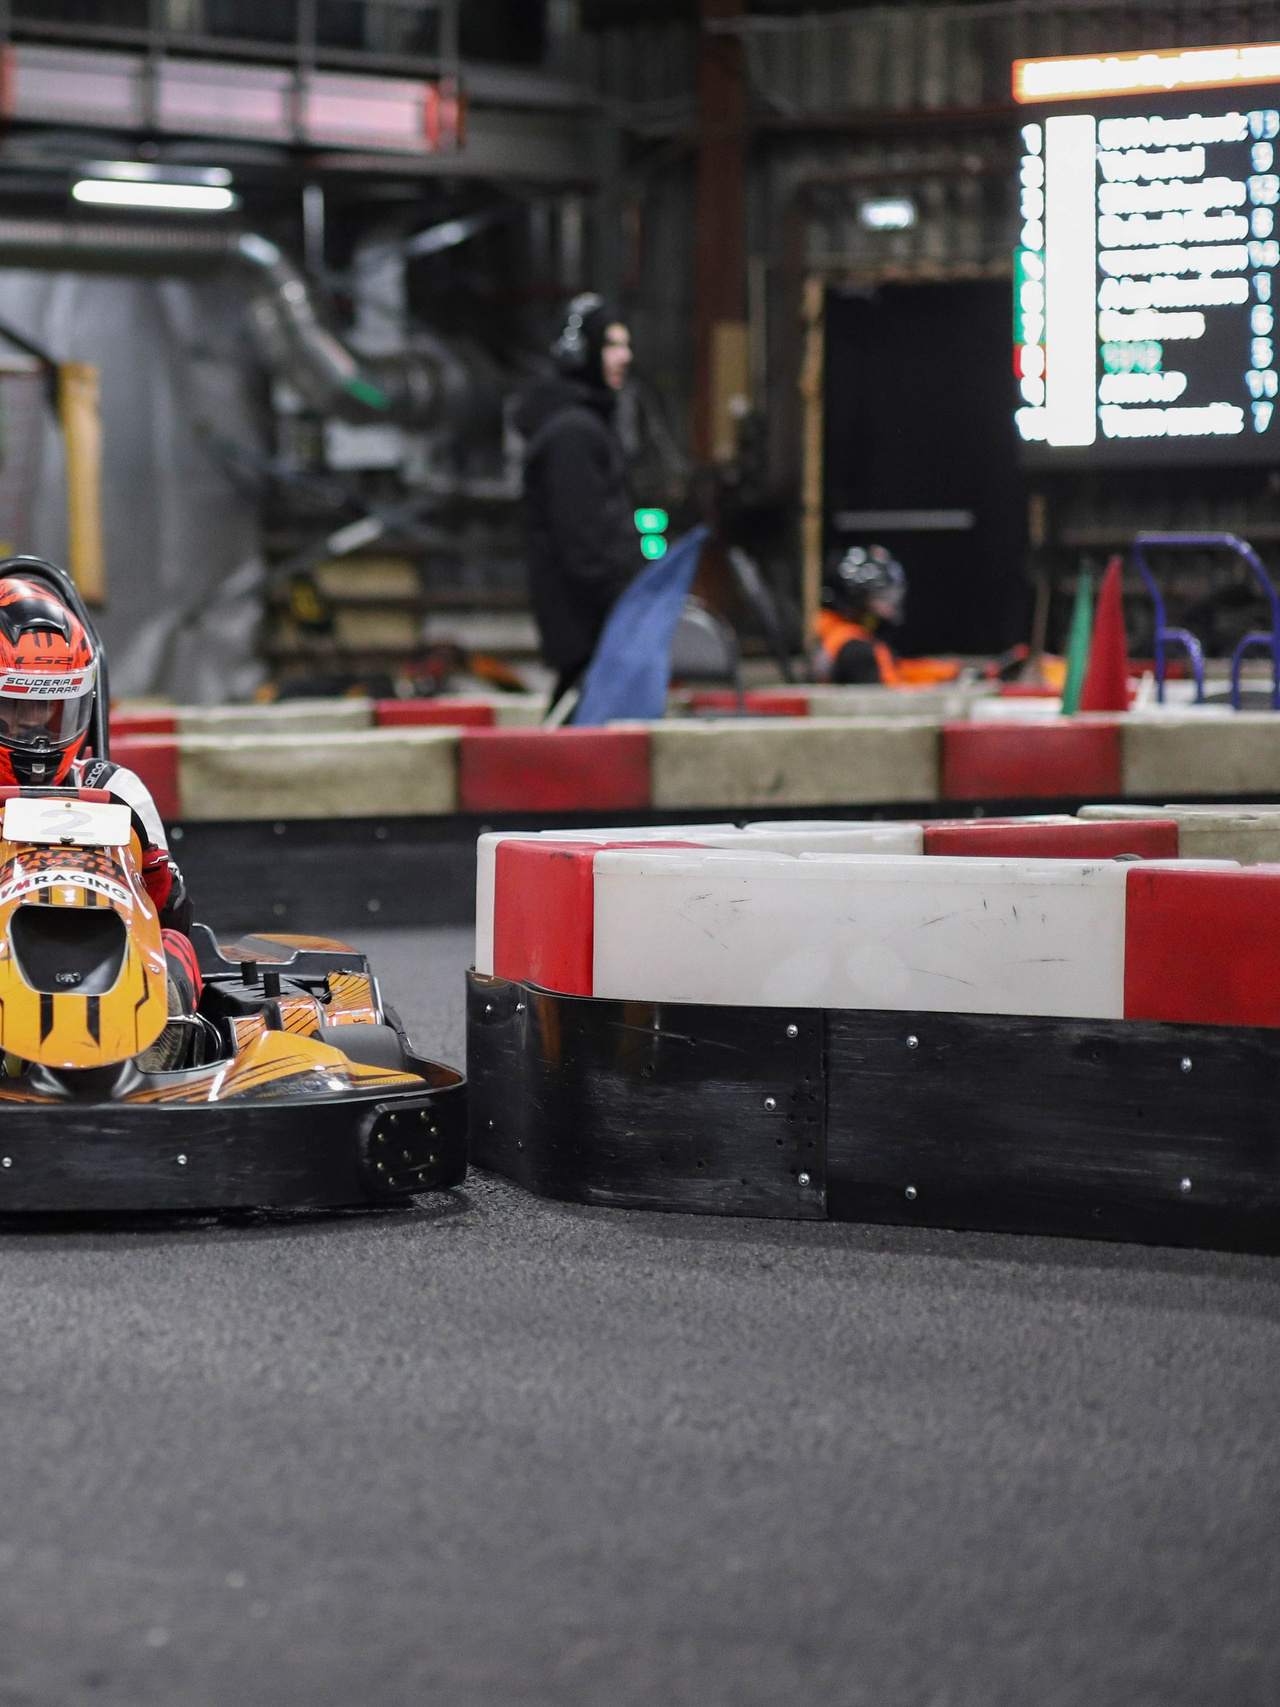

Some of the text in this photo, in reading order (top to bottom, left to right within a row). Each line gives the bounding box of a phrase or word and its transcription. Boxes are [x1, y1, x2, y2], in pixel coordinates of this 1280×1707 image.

[15, 656, 73, 665] LS2
[5, 677, 71, 687] SCUDERIA
[29, 685, 80, 695] FERRARI
[40, 809, 95, 837] 2
